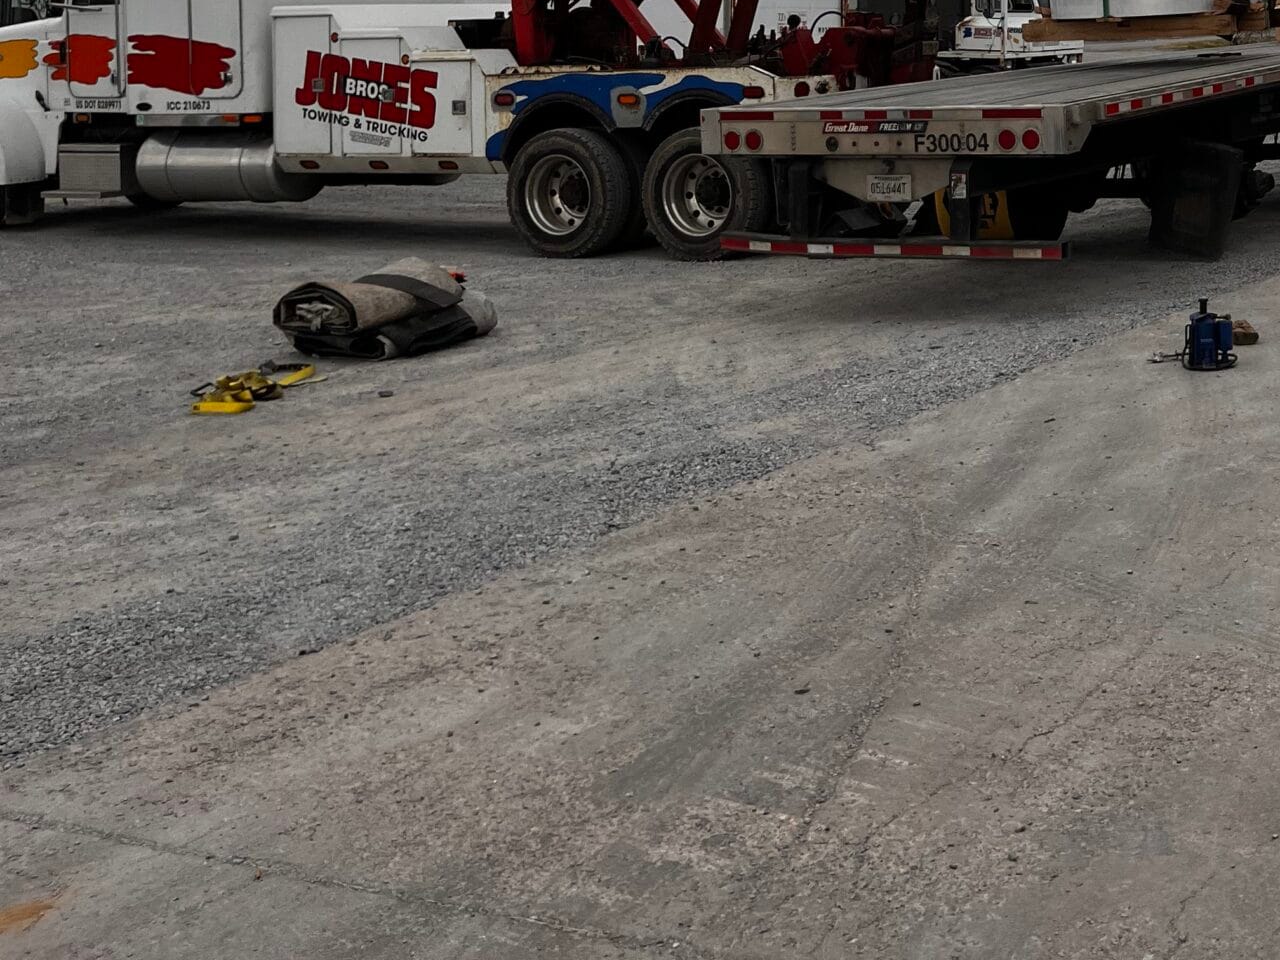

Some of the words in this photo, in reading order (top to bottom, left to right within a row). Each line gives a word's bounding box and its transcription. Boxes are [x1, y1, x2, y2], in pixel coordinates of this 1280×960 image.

[295, 50, 438, 129] JONES
[302, 107, 350, 127] TOWING
[353, 118, 363, 129] &
[365, 120, 429, 142] TRUCKING
[824, 122, 848, 133] Great
[847, 122, 869, 133] Dane
